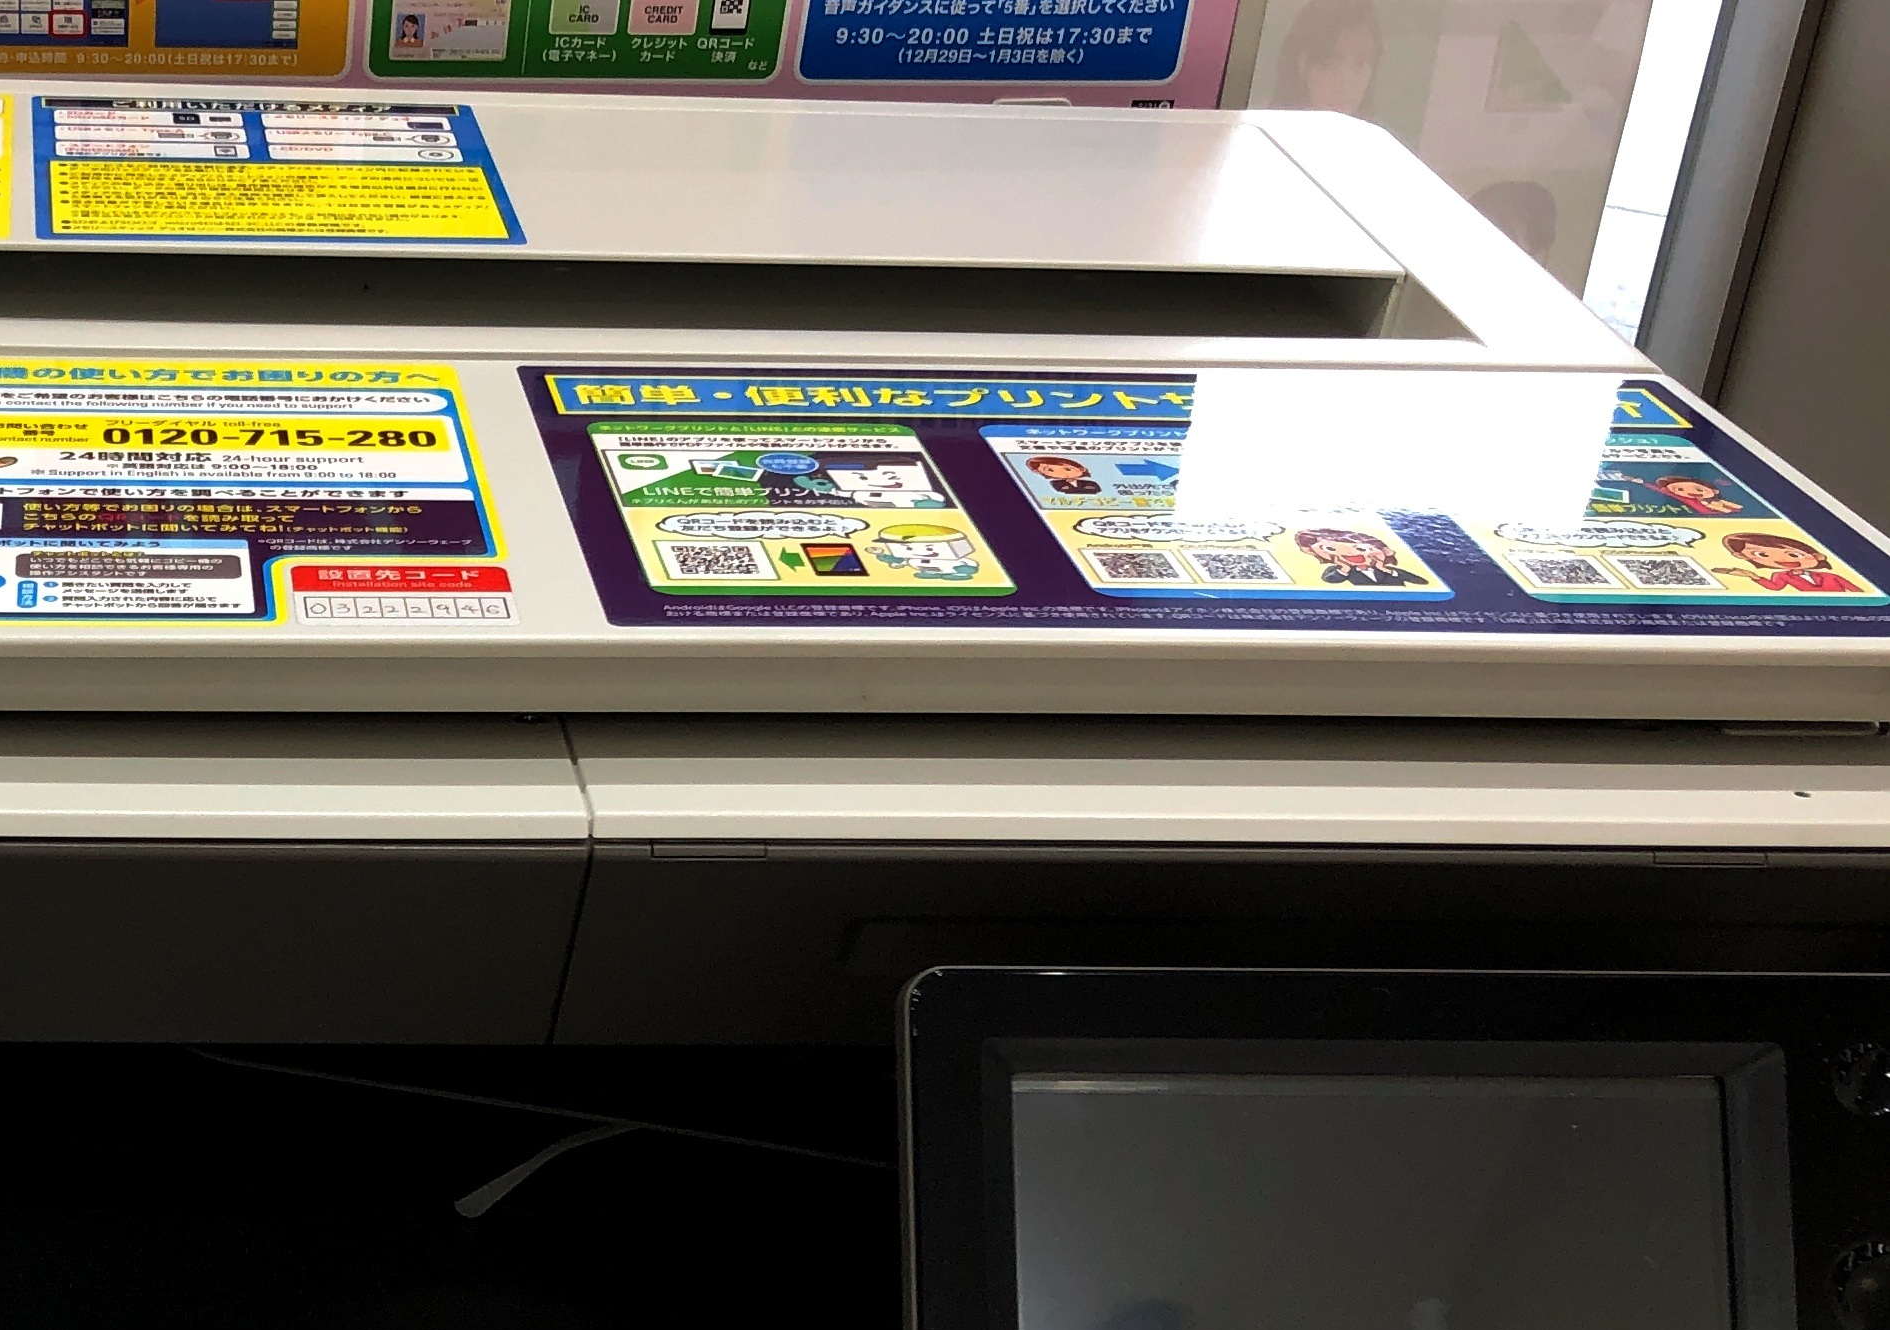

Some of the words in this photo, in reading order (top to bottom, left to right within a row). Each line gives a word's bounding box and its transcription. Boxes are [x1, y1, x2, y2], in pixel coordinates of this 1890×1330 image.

[579, 5, 590, 13] IC
[644, 5, 684, 15] CREDIT
[568, 13, 599, 23] CARD
[647, 14, 678, 24] CARD
[555, 36, 607, 49] ICカード
[631, 37, 688, 49] クレジット
[697, 37, 755, 50] QRコード
[639, 50, 677, 63] カード
[86, 400, 147, 408] following
[102, 427, 437, 447] 0120-715-280
[59, 451, 212, 462] 24時間対応
[222, 455, 291, 463] 24-hour
[296, 455, 364, 464] support
[48, 469, 106, 477] Support
[318, 569, 480, 580] 設置先コード
